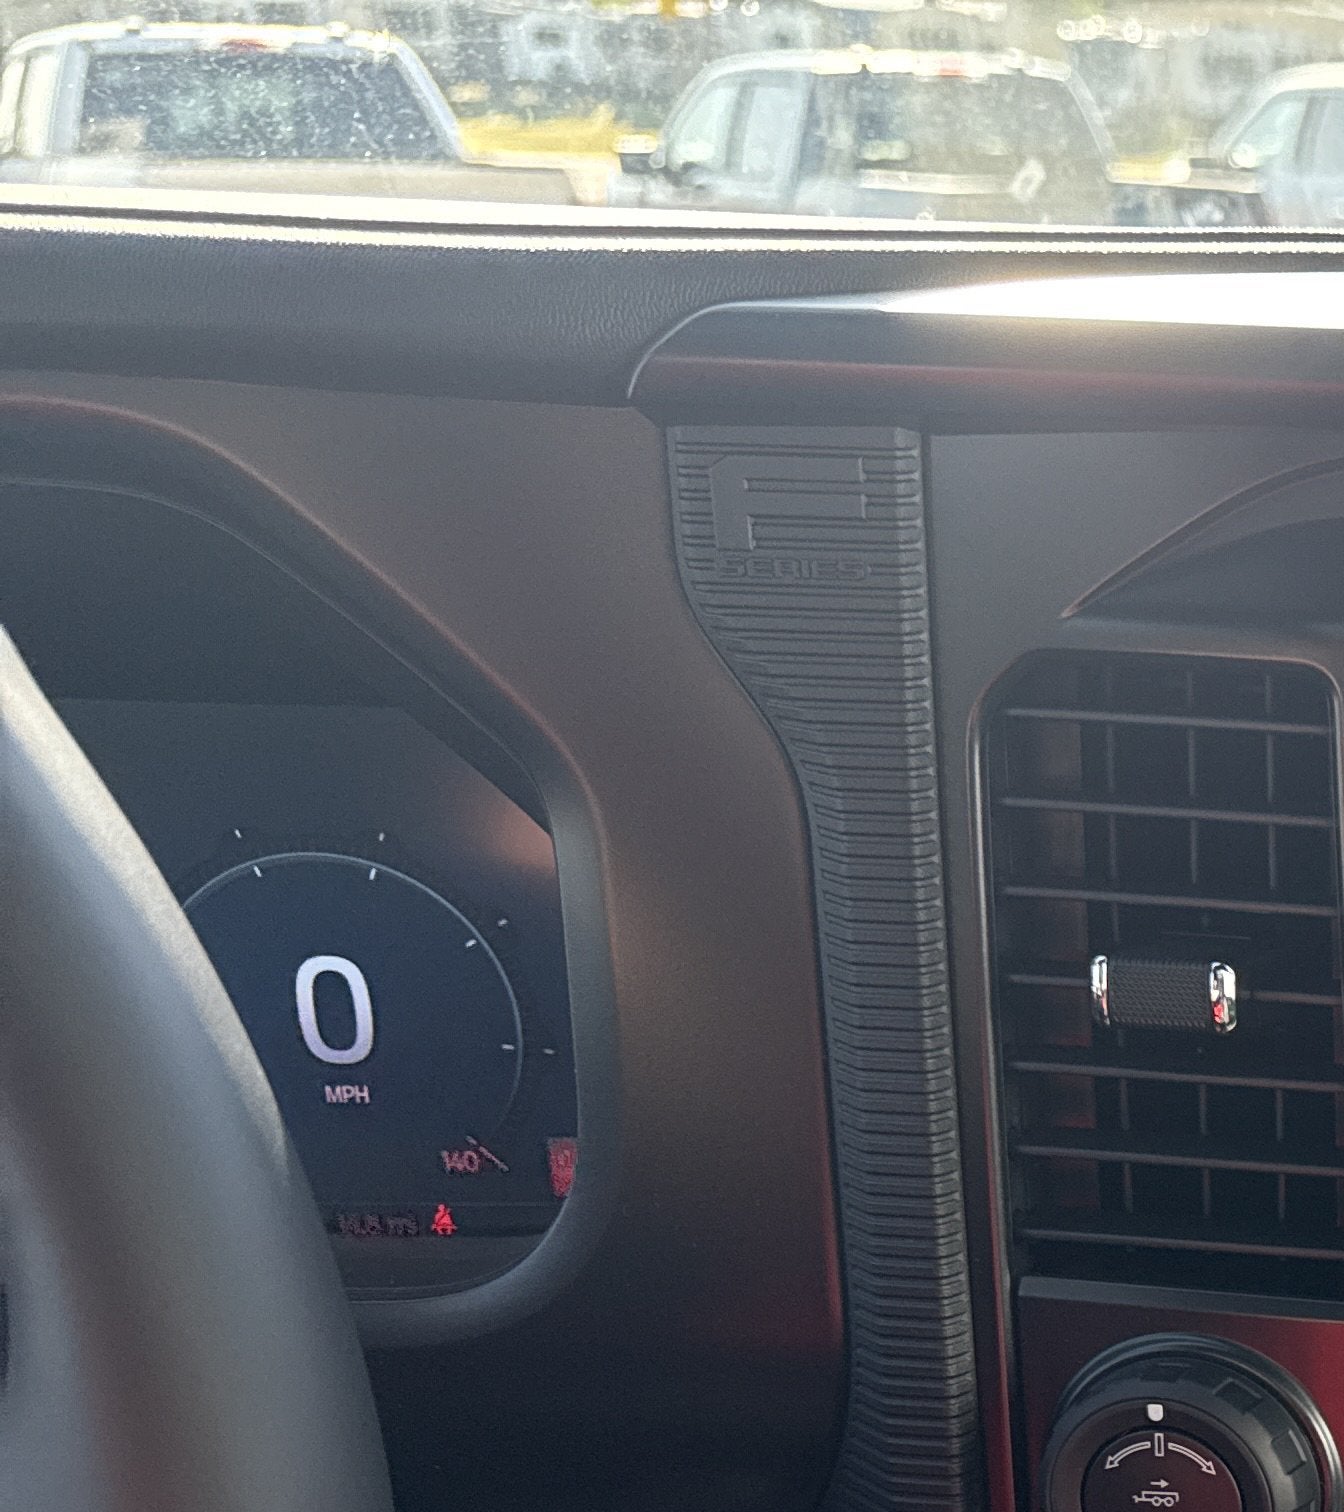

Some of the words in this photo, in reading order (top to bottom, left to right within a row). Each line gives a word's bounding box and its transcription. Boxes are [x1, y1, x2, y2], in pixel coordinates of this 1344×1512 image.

[718, 556, 868, 581] SERIES
[296, 955, 374, 1064] 0
[325, 1084, 370, 1104] MPH
